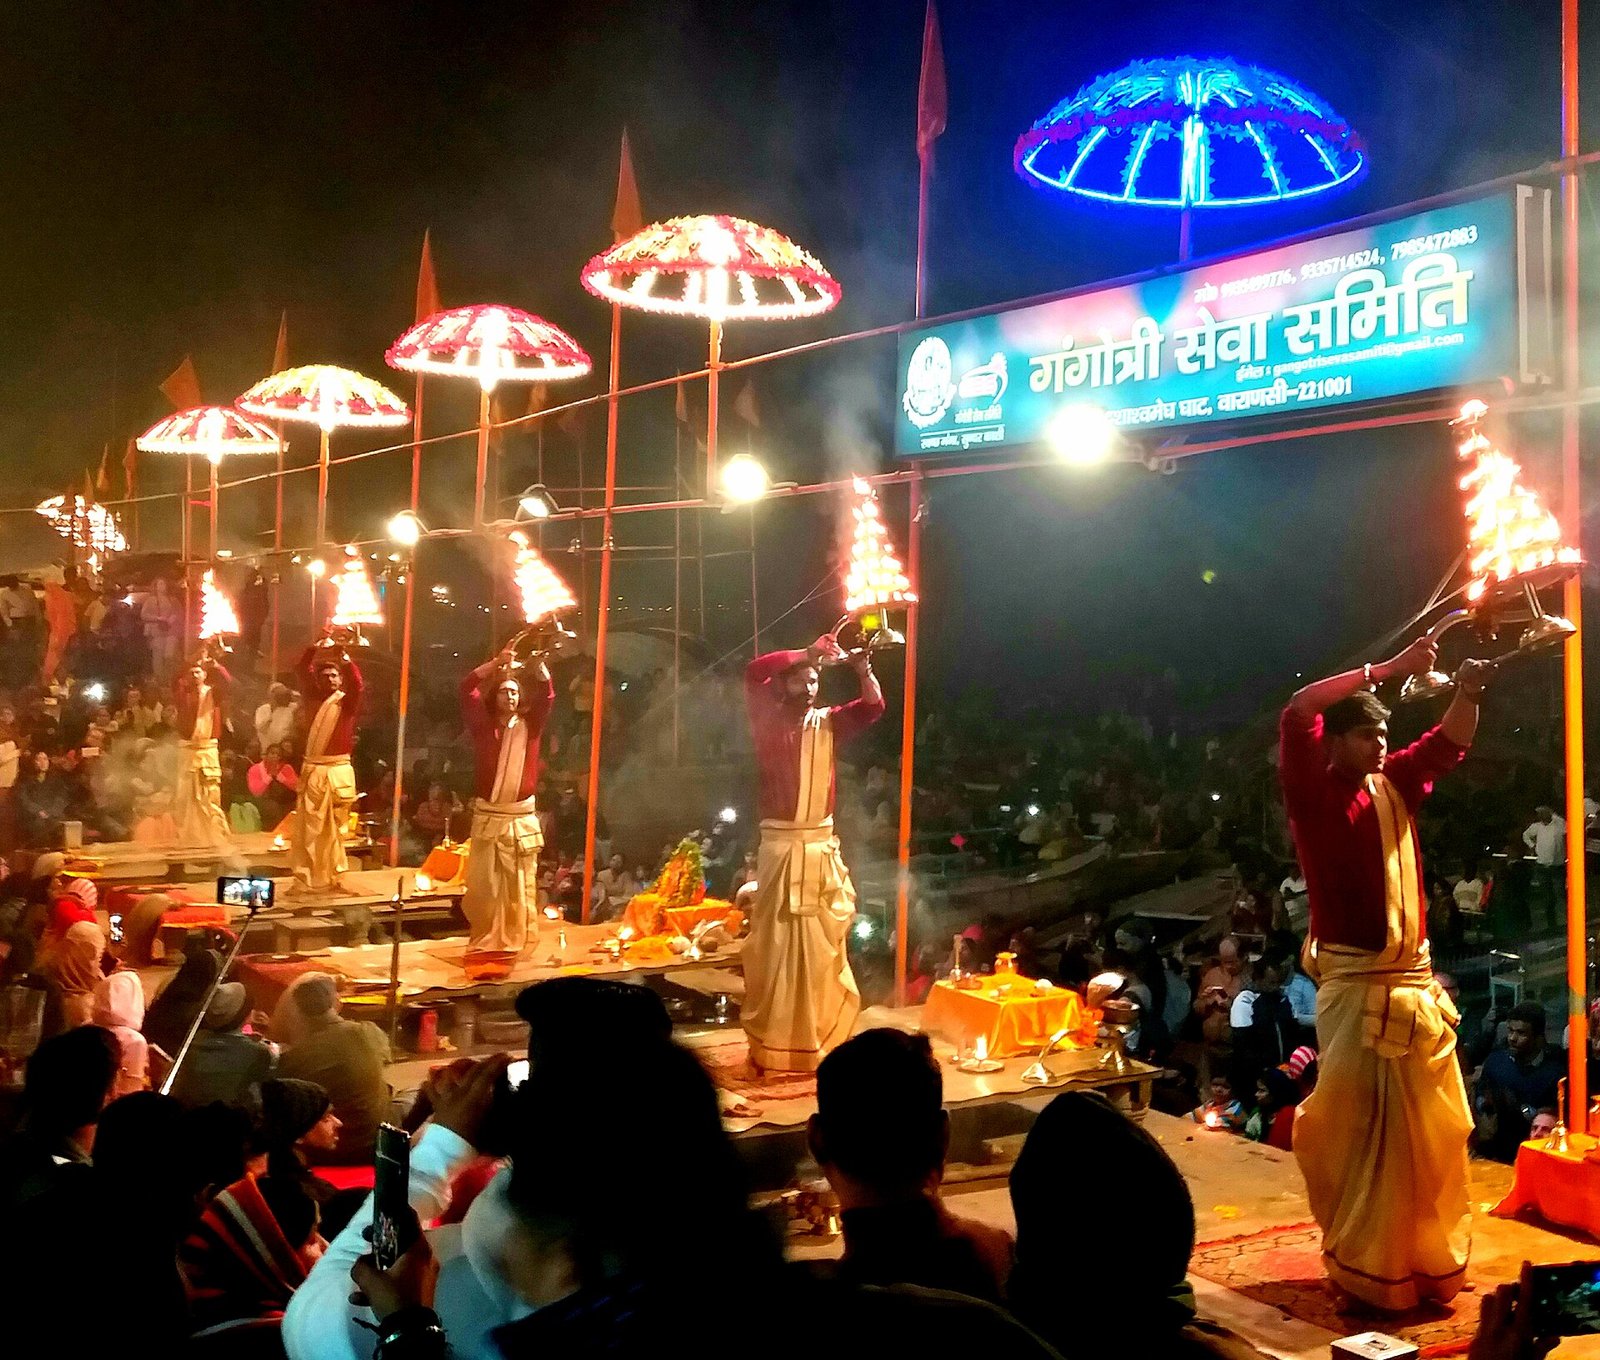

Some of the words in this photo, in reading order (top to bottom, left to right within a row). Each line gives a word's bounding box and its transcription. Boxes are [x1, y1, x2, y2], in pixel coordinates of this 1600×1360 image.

[1028, 316, 1166, 395] गंगोत्री
[1173, 306, 1273, 376] सेवा
[1282, 252, 1474, 356] समिति
[1178, 397, 1214, 418] घाट,
